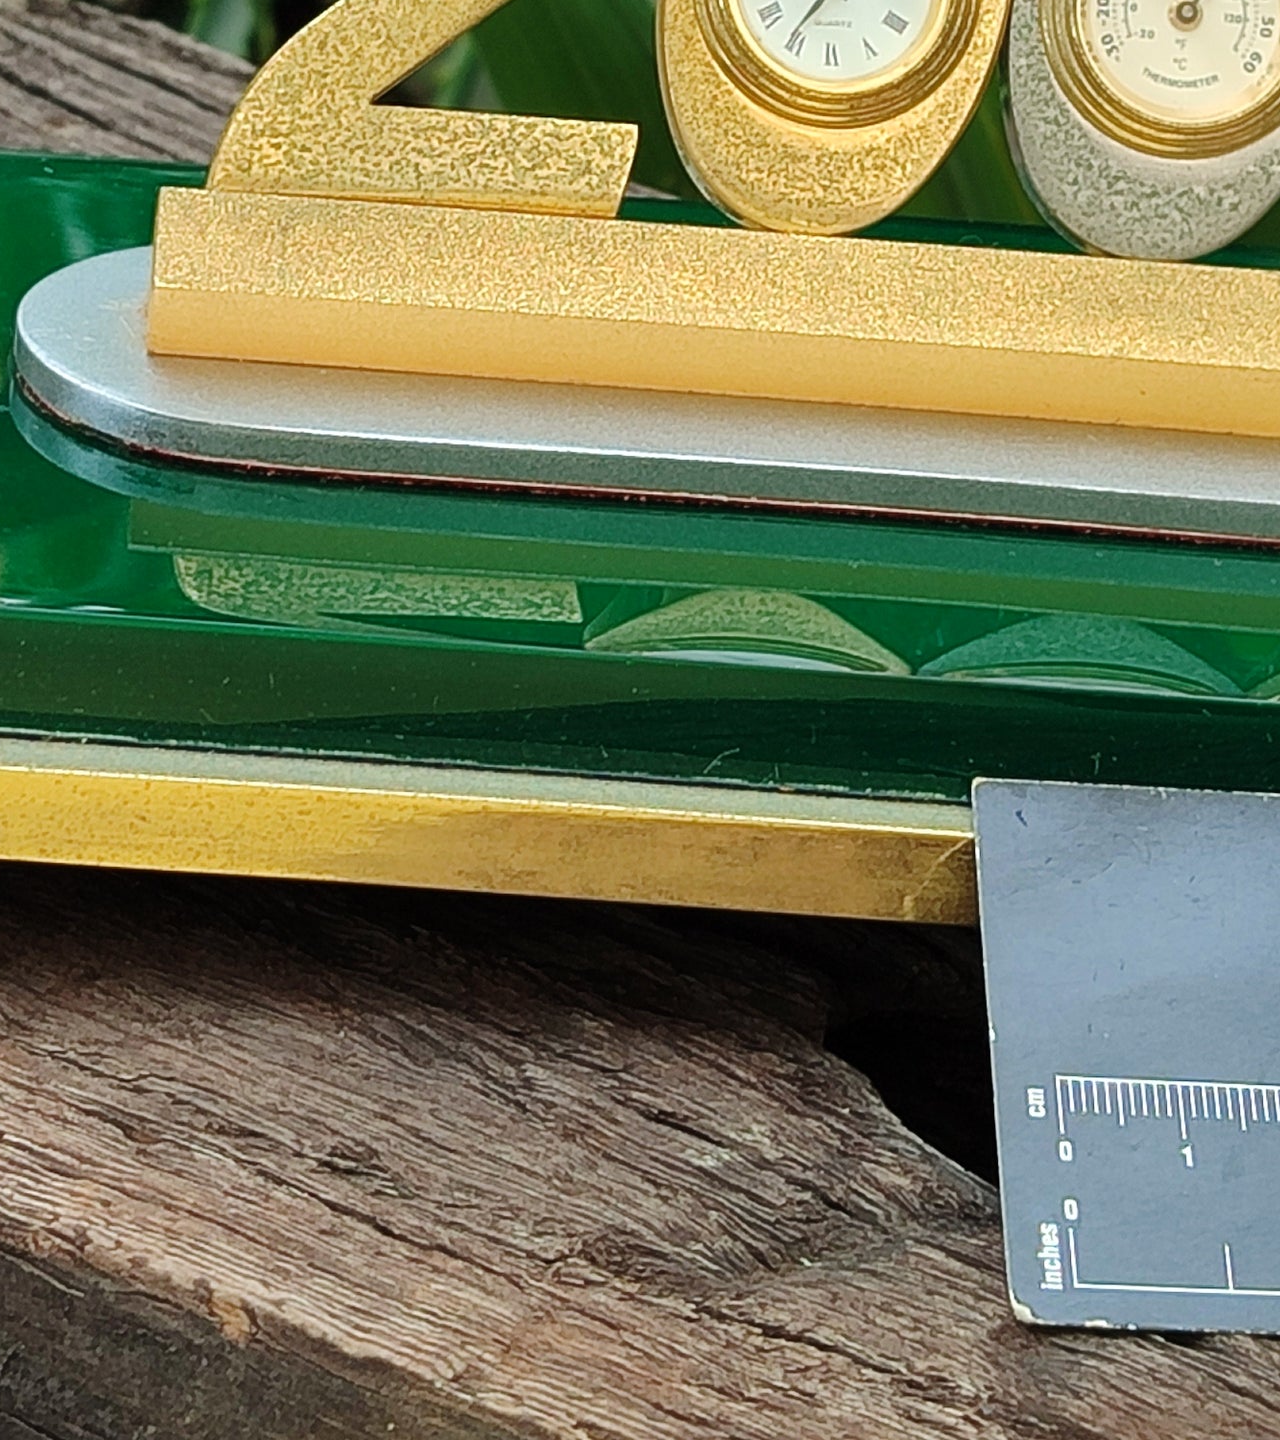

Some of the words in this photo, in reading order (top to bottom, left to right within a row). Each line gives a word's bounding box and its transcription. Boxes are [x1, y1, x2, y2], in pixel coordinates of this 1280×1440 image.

[1260, 16, 1274, 38] 50
[1242, 52, 1262, 74] 60
[1142, 67, 1220, 88] THERMOMETER
[1027, 1087, 1046, 1118] cm
[1058, 1140, 1074, 1162] 0
[1180, 1145, 1195, 1168] 1
[1063, 1198, 1078, 1221] 0
[1037, 1222, 1064, 1292] inches
